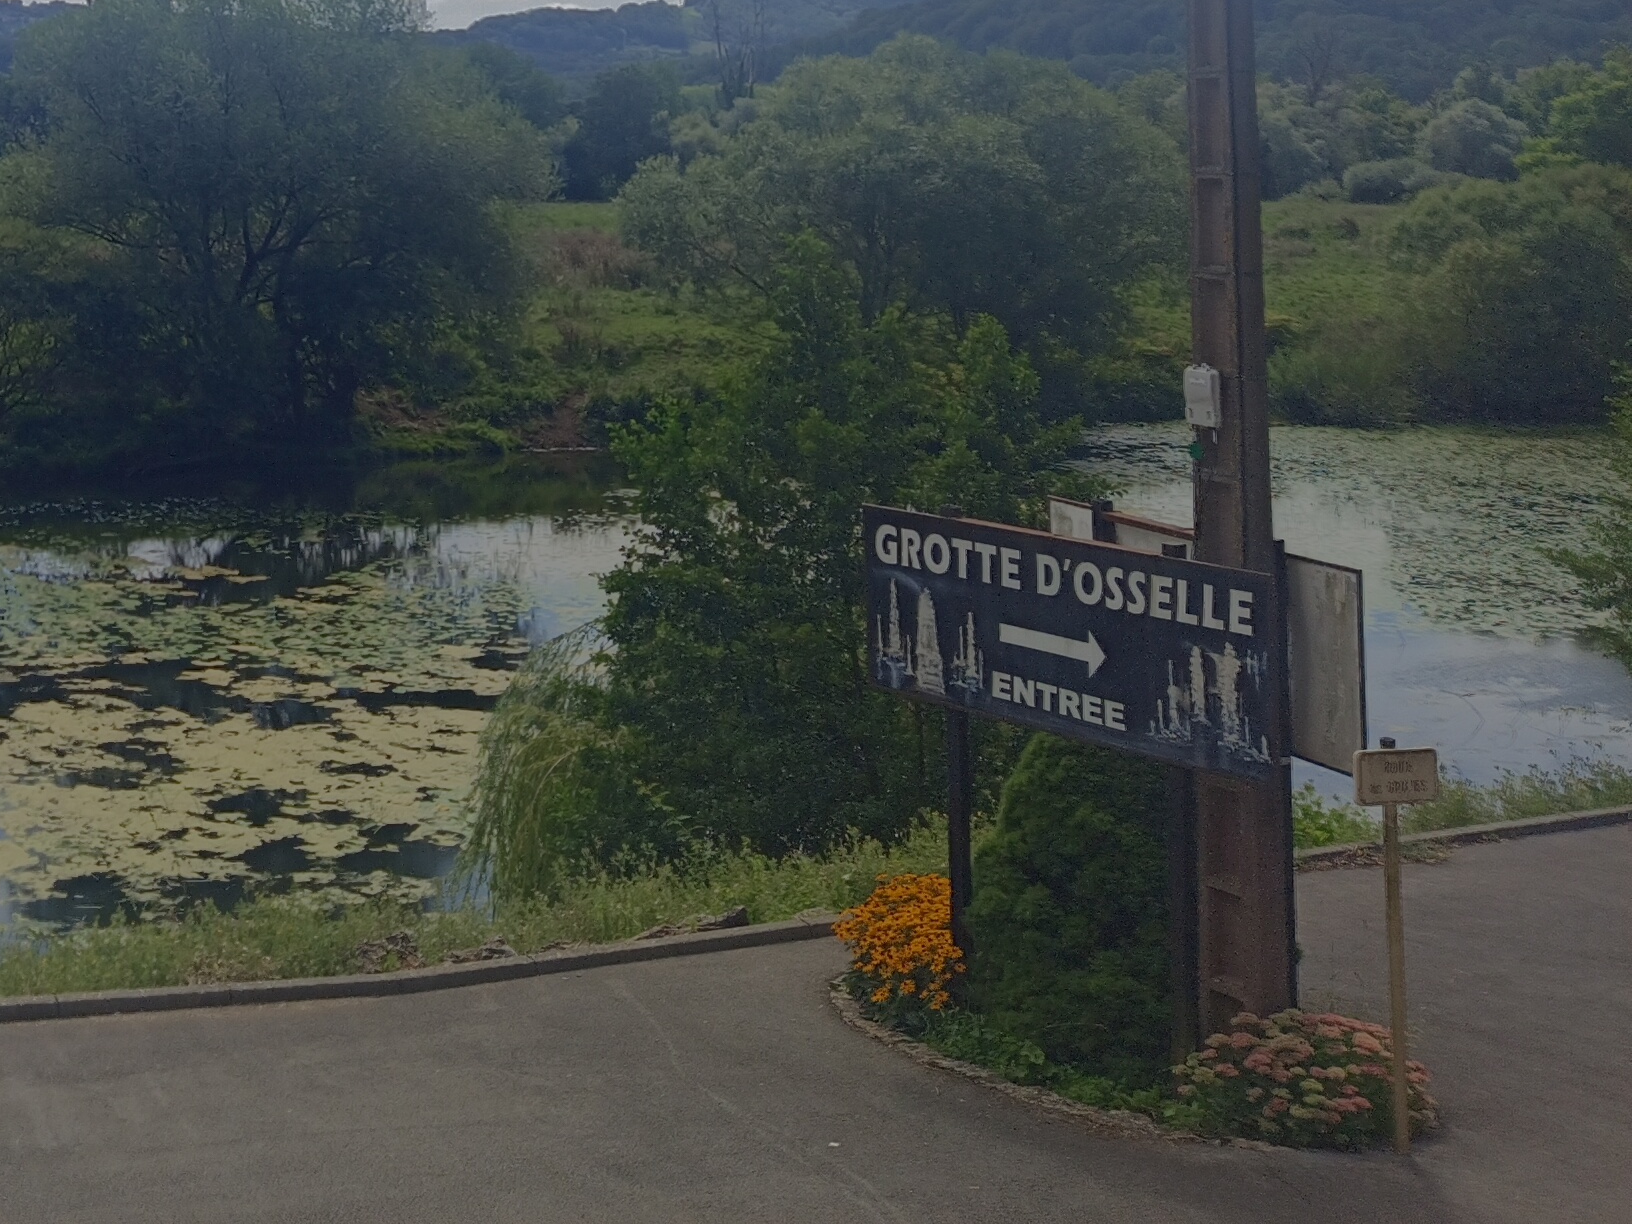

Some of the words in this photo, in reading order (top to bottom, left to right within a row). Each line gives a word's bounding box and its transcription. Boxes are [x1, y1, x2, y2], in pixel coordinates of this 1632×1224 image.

[874, 524, 1022, 590] GROTTE
[1036, 553, 1255, 637] D'OSSELLE
[991, 670, 1128, 732] ENTREE
